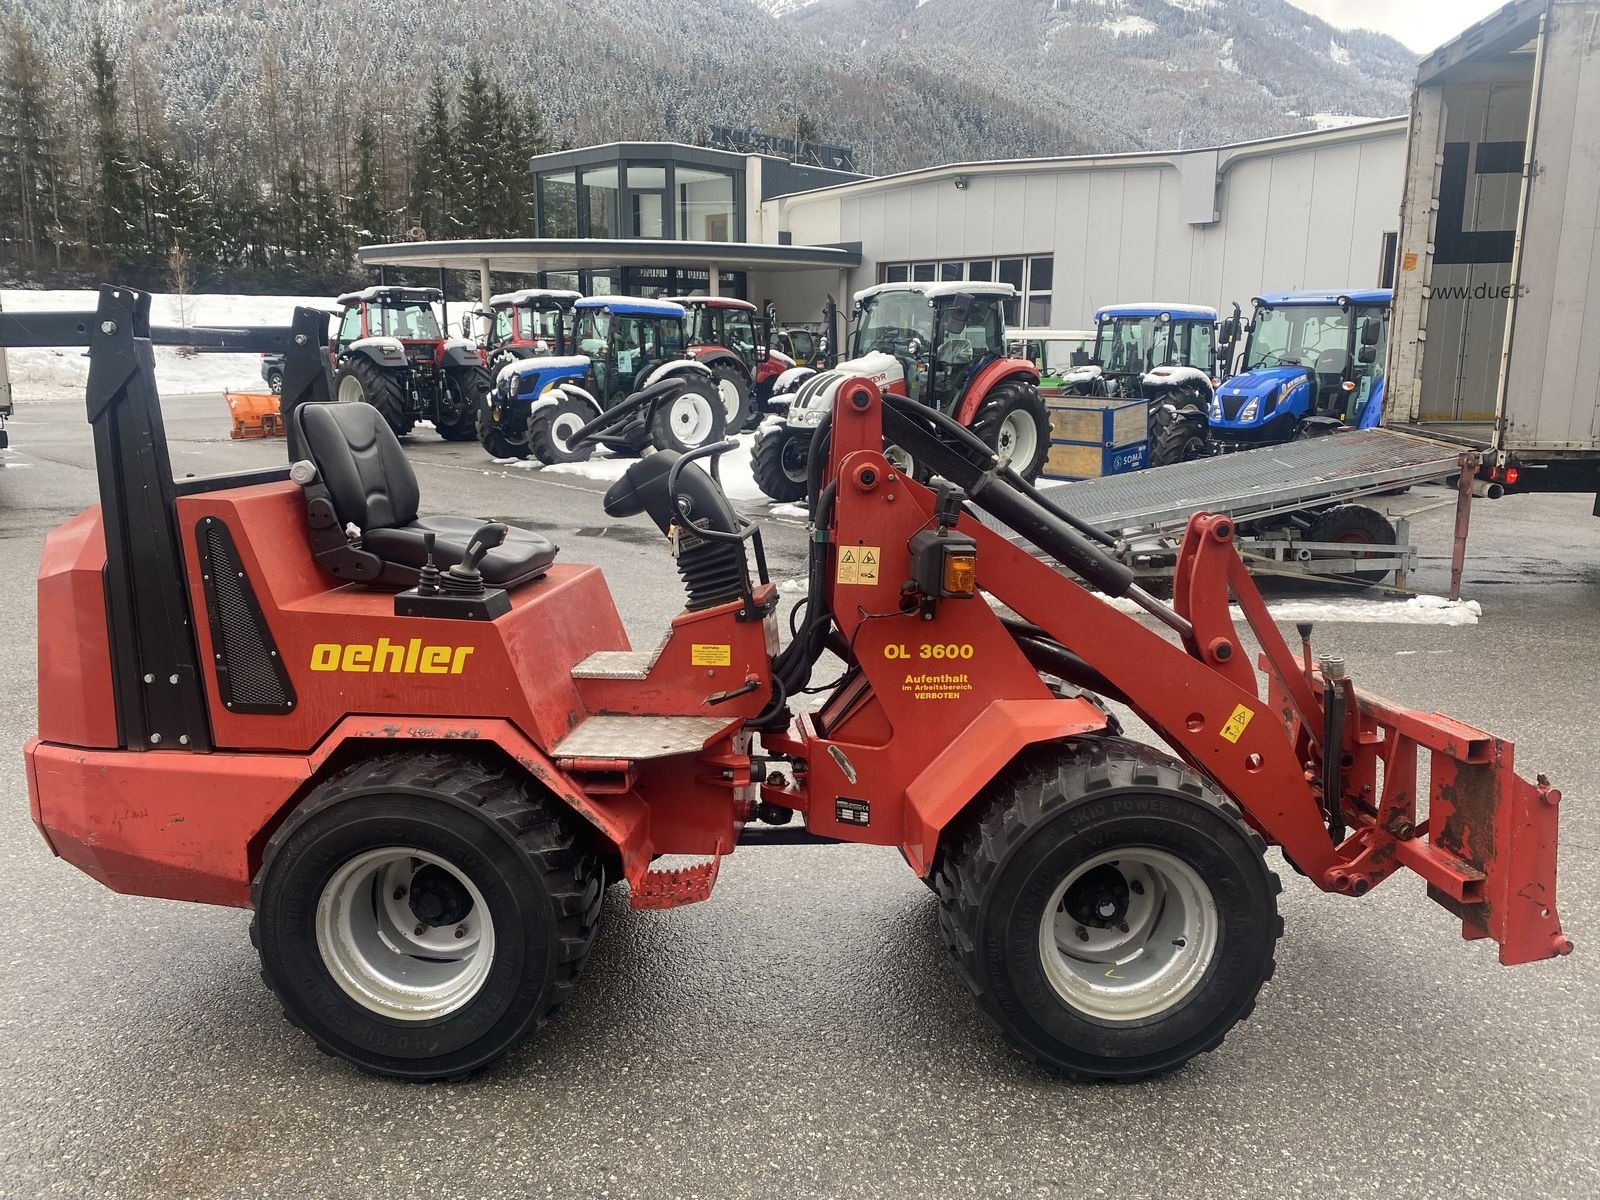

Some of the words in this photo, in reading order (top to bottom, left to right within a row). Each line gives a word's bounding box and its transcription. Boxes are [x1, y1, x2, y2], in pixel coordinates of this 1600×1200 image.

[310, 637, 475, 674] oehler
[884, 644, 911, 659] OL
[919, 644, 974, 659] 3600
[905, 674, 968, 684] Aufenthalt
[914, 692, 960, 700] VERBOTEN
[1069, 804, 1106, 826] SKID
[1112, 799, 1169, 813] POWER
